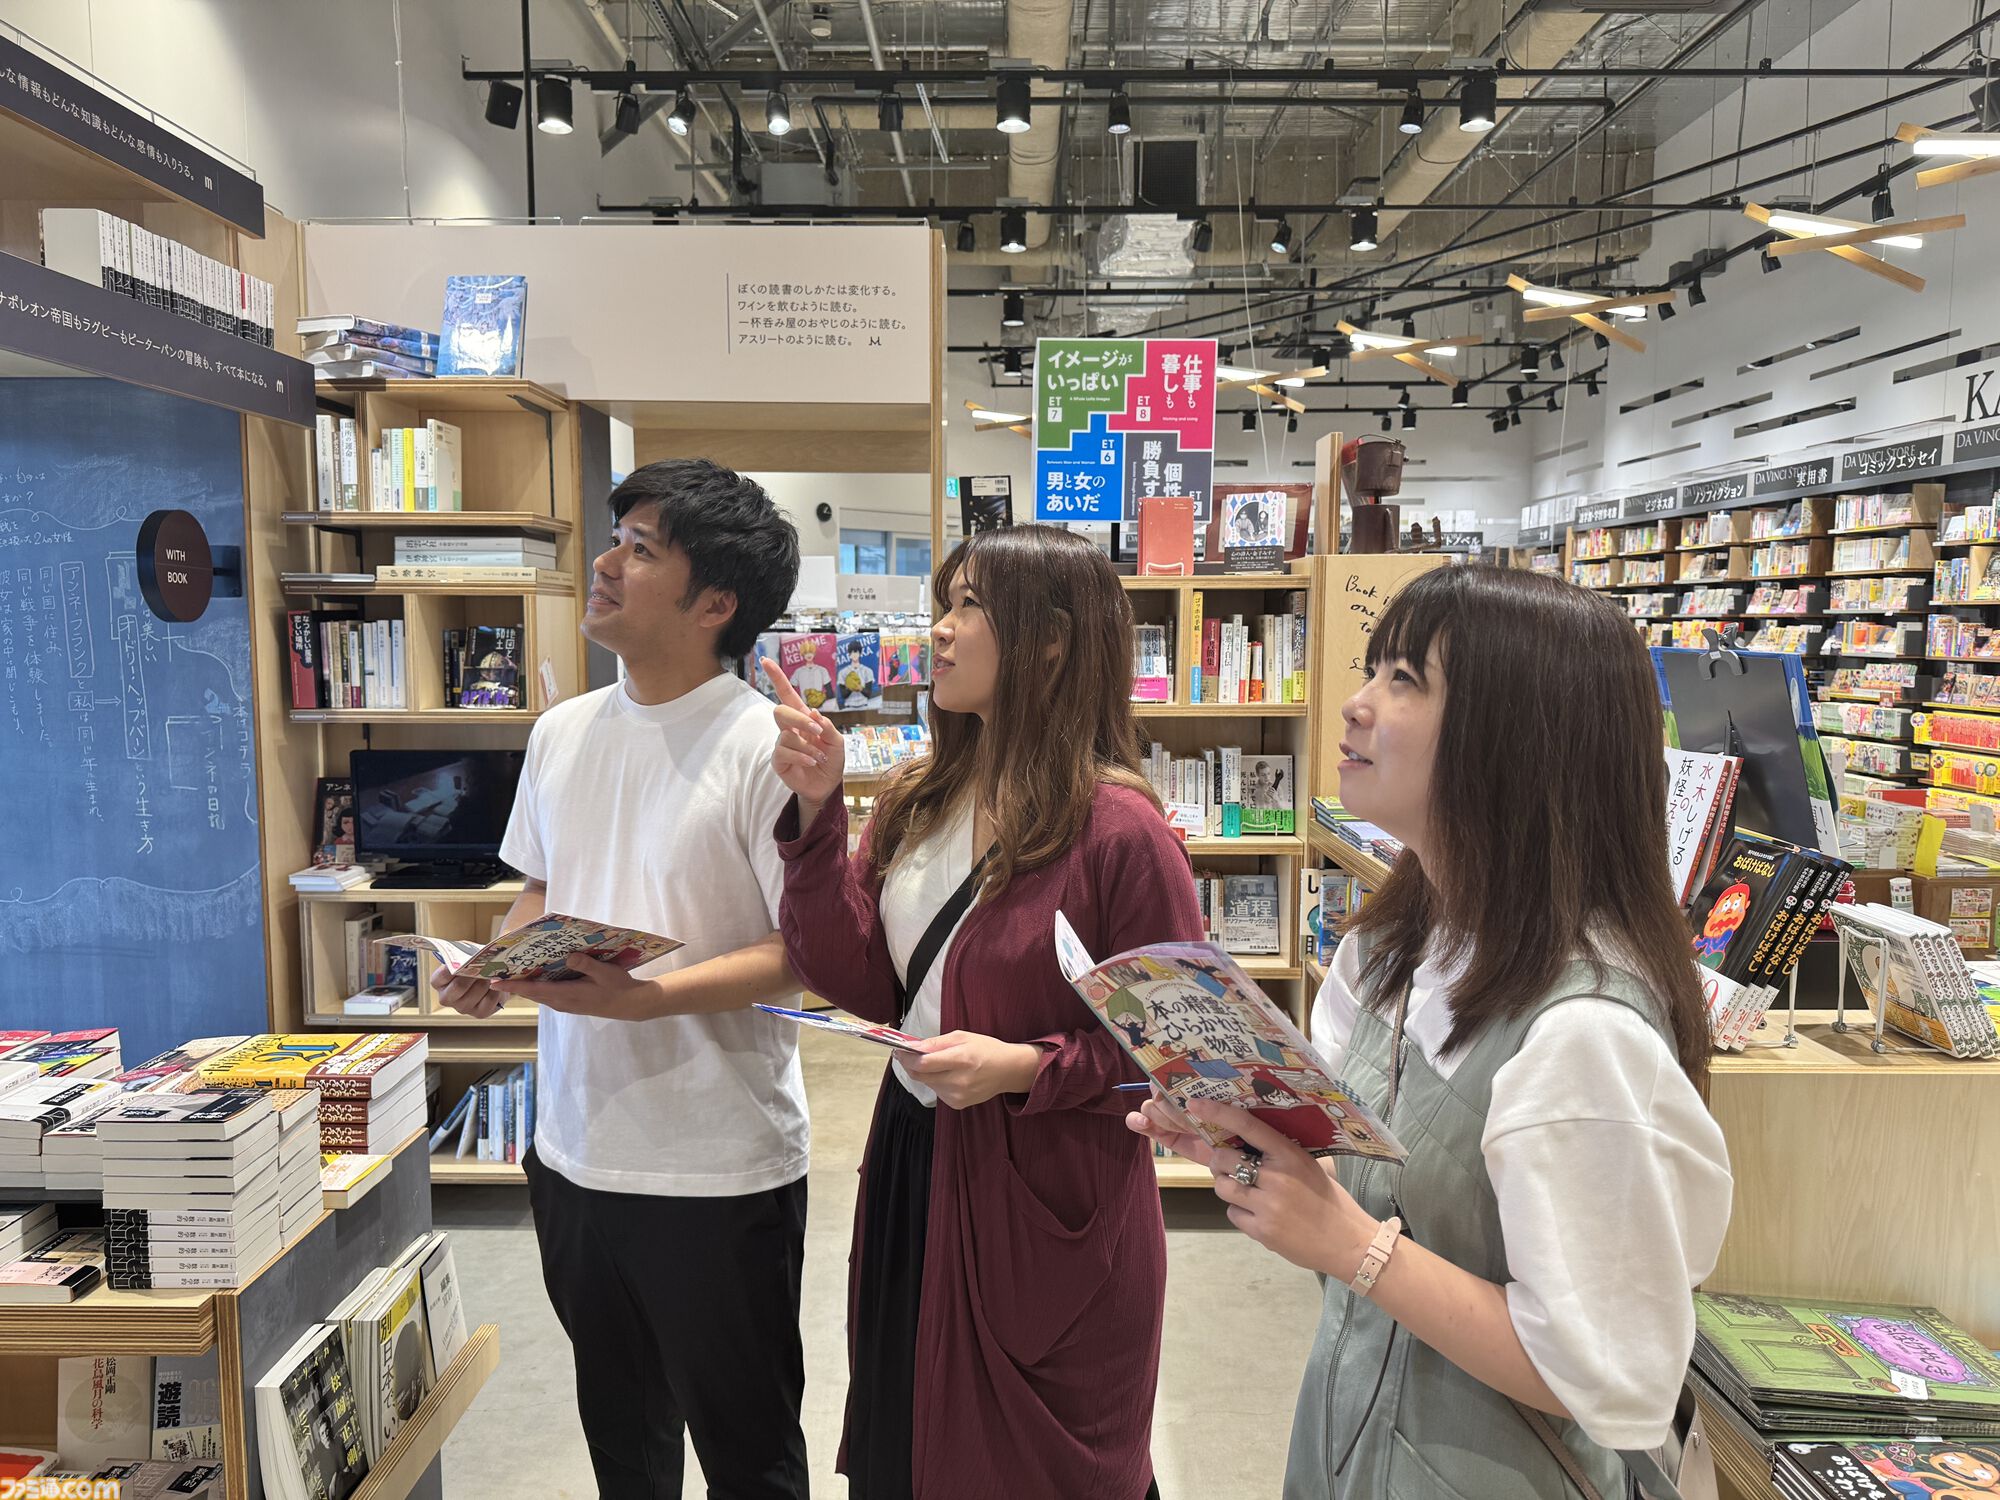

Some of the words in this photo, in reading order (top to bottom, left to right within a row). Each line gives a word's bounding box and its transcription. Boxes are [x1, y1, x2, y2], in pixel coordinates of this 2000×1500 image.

[738, 284, 897, 297] ぼくの読書のしかたは変化する。
[738, 301, 857, 313] ワインを飲むように読む。
[739, 317, 906, 330] 一杯呑み屋のおやじのように読む。
[739, 334, 852, 346] アスリートのように読む。
[1048, 349, 1133, 369] イメージが
[1048, 373, 1119, 391] いっぱい
[1162, 354, 1181, 408] 暮しも
[1183, 354, 1202, 408] 仕事も
[1049, 397, 1062, 406] ET
[1137, 396, 1150, 405] ET
[1962, 370, 2000, 423] K
[1052, 410, 1057, 420] 7
[1140, 409, 1146, 419] 8
[1102, 440, 1114, 448] ET
[1956, 433, 1972, 447] DA
[1104, 452, 1111, 462] 6
[1844, 455, 1857, 468] DA
[1859, 448, 1938, 475] コミックエッセイ
[1046, 471, 1105, 491] 男と女の
[1755, 471, 1766, 484] DA
[1796, 467, 1828, 488] 実用書
[1046, 494, 1100, 512] あいだ
[1694, 484, 1744, 505] ノンフィクション
[166, 549, 186, 562] WITH
[168, 572, 188, 584] BOOK
[1345, 574, 1378, 598] Book
[1351, 604, 1380, 620] one
[783, 635, 828, 655] KANME
[1673, 761, 1714, 866] 水木しげる
[1733, 854, 1776, 878] おばけばなし
[1230, 900, 1272, 917] 道程
[1748, 909, 1789, 973] おばけばなし
[1764, 912, 1807, 975] おばけばなし
[1781, 912, 1823, 975] おばけばなし
[1148, 993, 1238, 1021] 本の精霊と
[1163, 1015, 1256, 1040] ひらかれた
[1204, 1034, 1253, 1059] 物語
[105, 1357, 116, 1394] 松岡正剛
[91, 1358, 104, 1430] 花鳥風月の科学
[157, 1381, 182, 1429] 遊読
